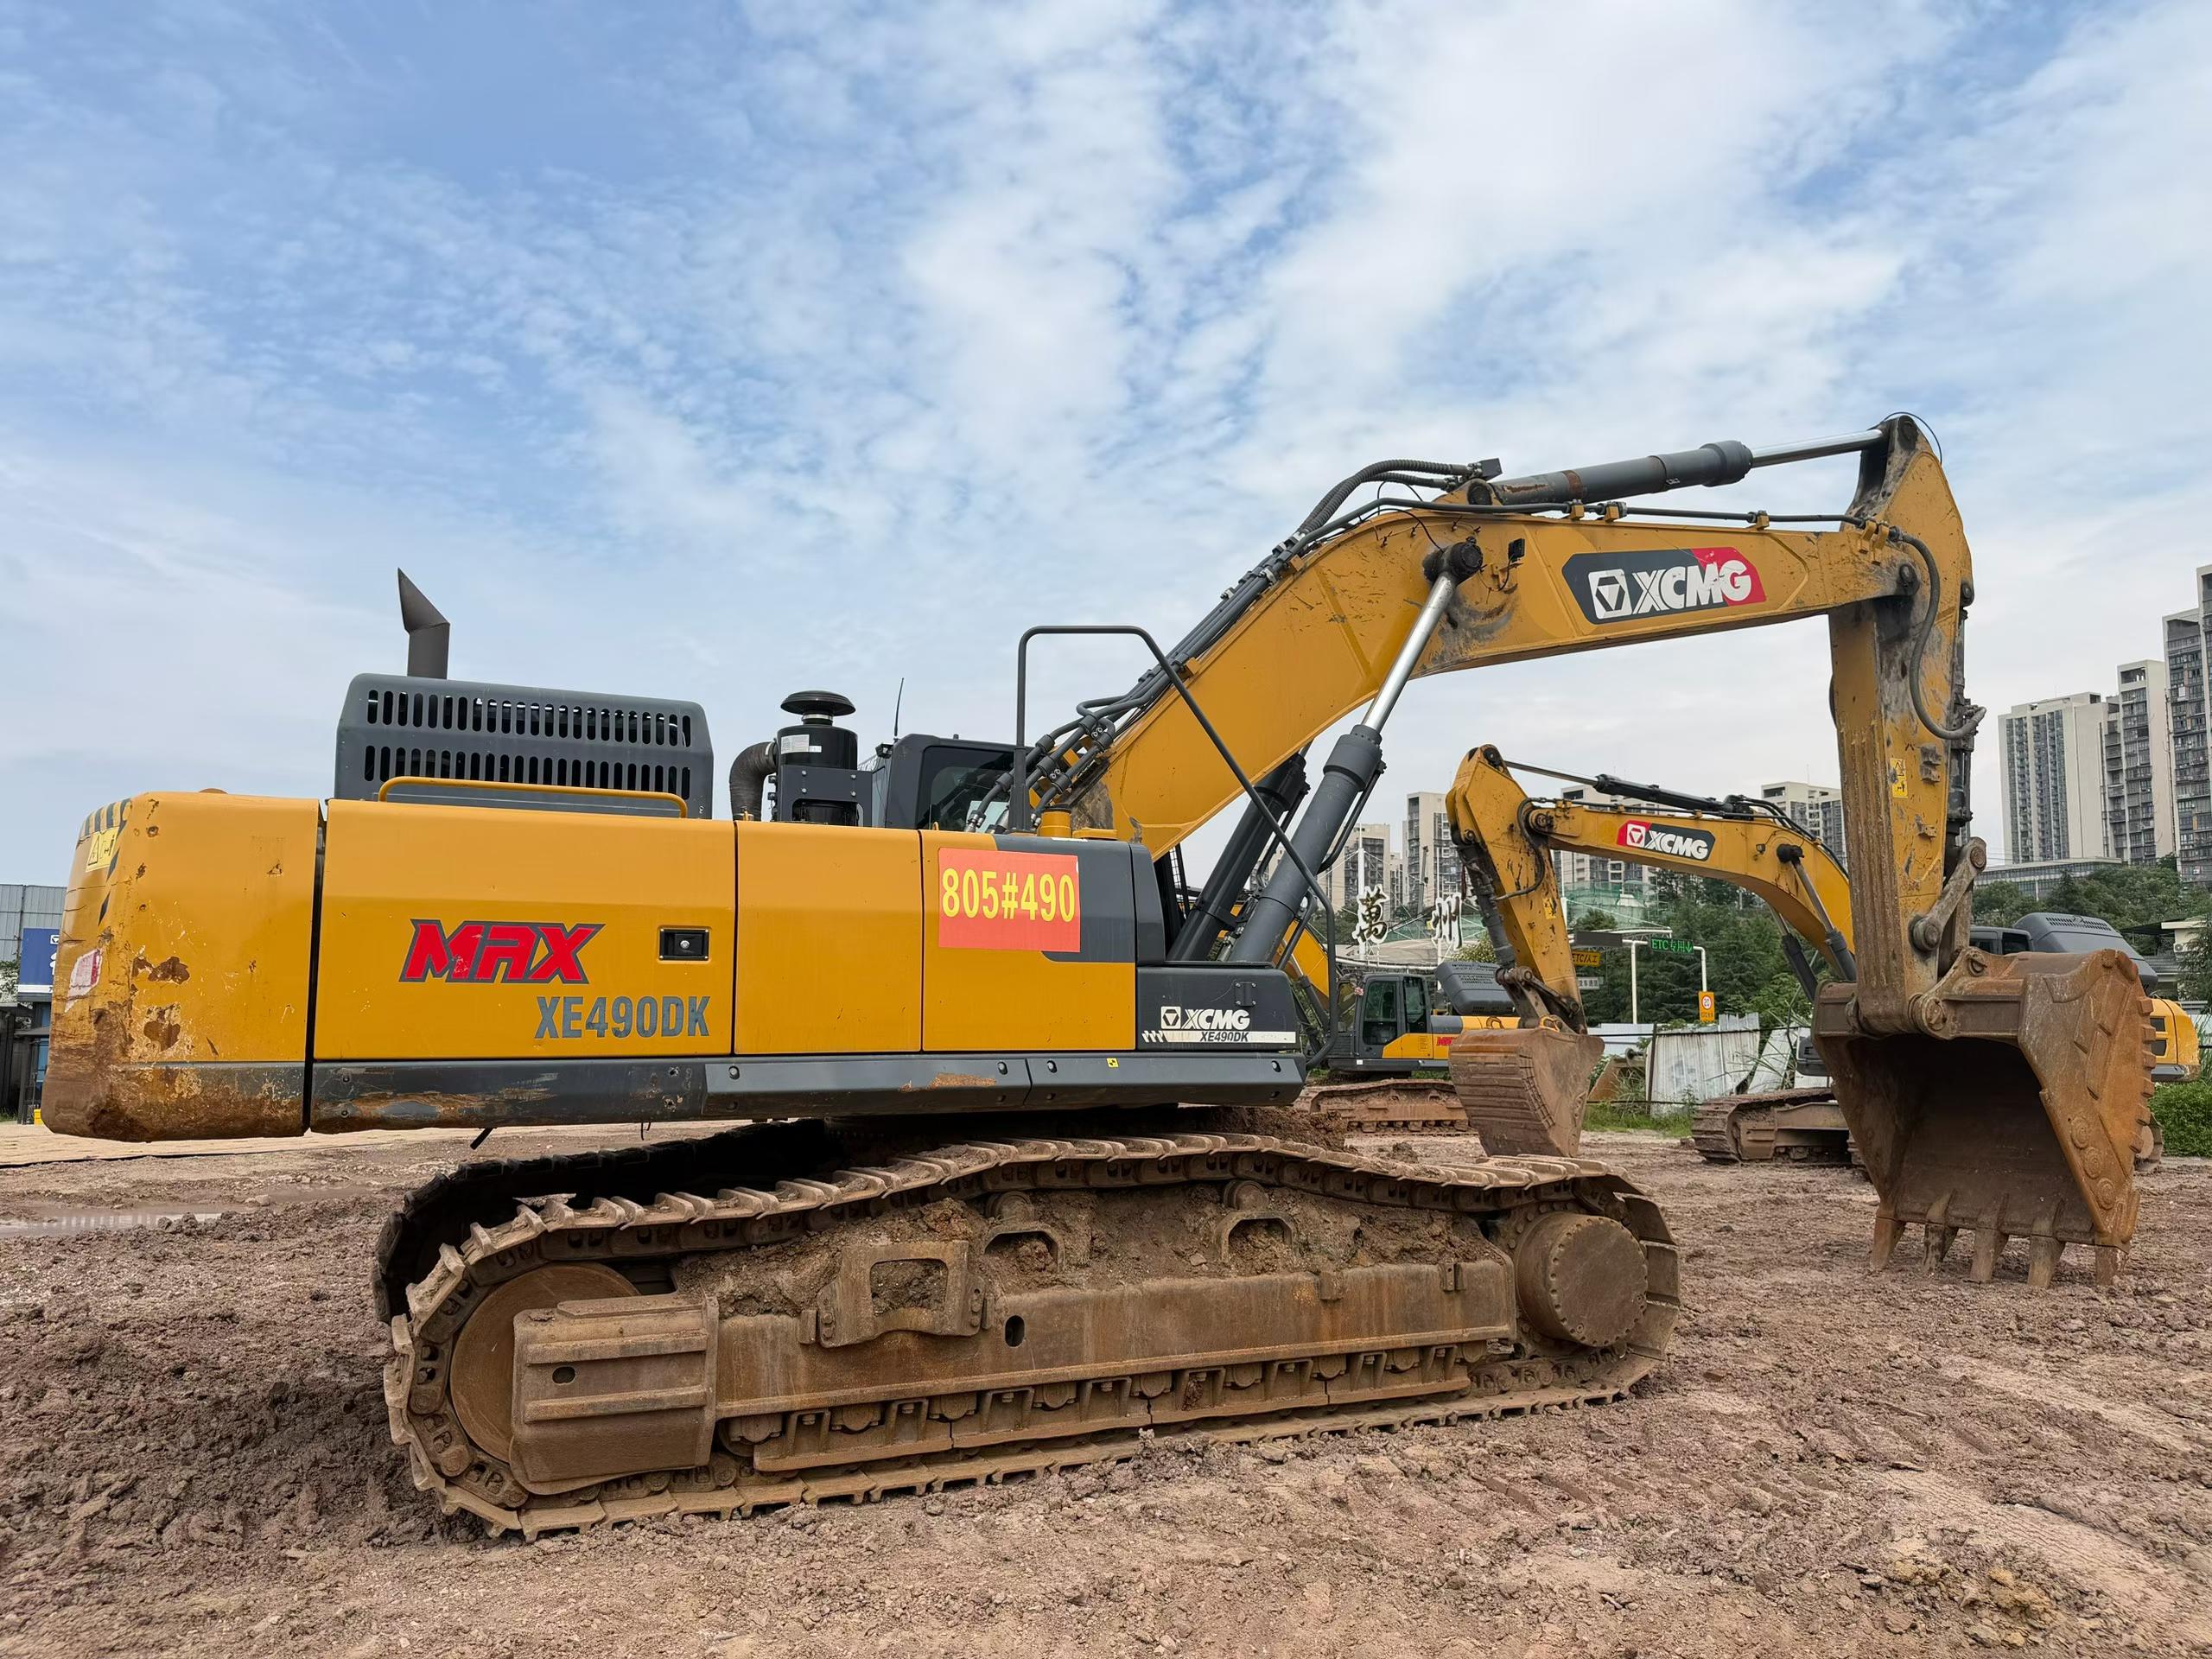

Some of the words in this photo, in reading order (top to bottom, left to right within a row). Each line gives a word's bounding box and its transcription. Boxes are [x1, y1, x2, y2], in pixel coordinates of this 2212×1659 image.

[1631, 559, 1752, 615] XCMG
[1643, 830, 1709, 861] XCMG
[942, 868, 1076, 923] 805#490
[398, 918, 606, 985] MAX
[533, 995, 711, 1039] XE490DK
[1180, 1008, 1250, 1030] XCMG
[1199, 1032, 1249, 1042] XE490DK
